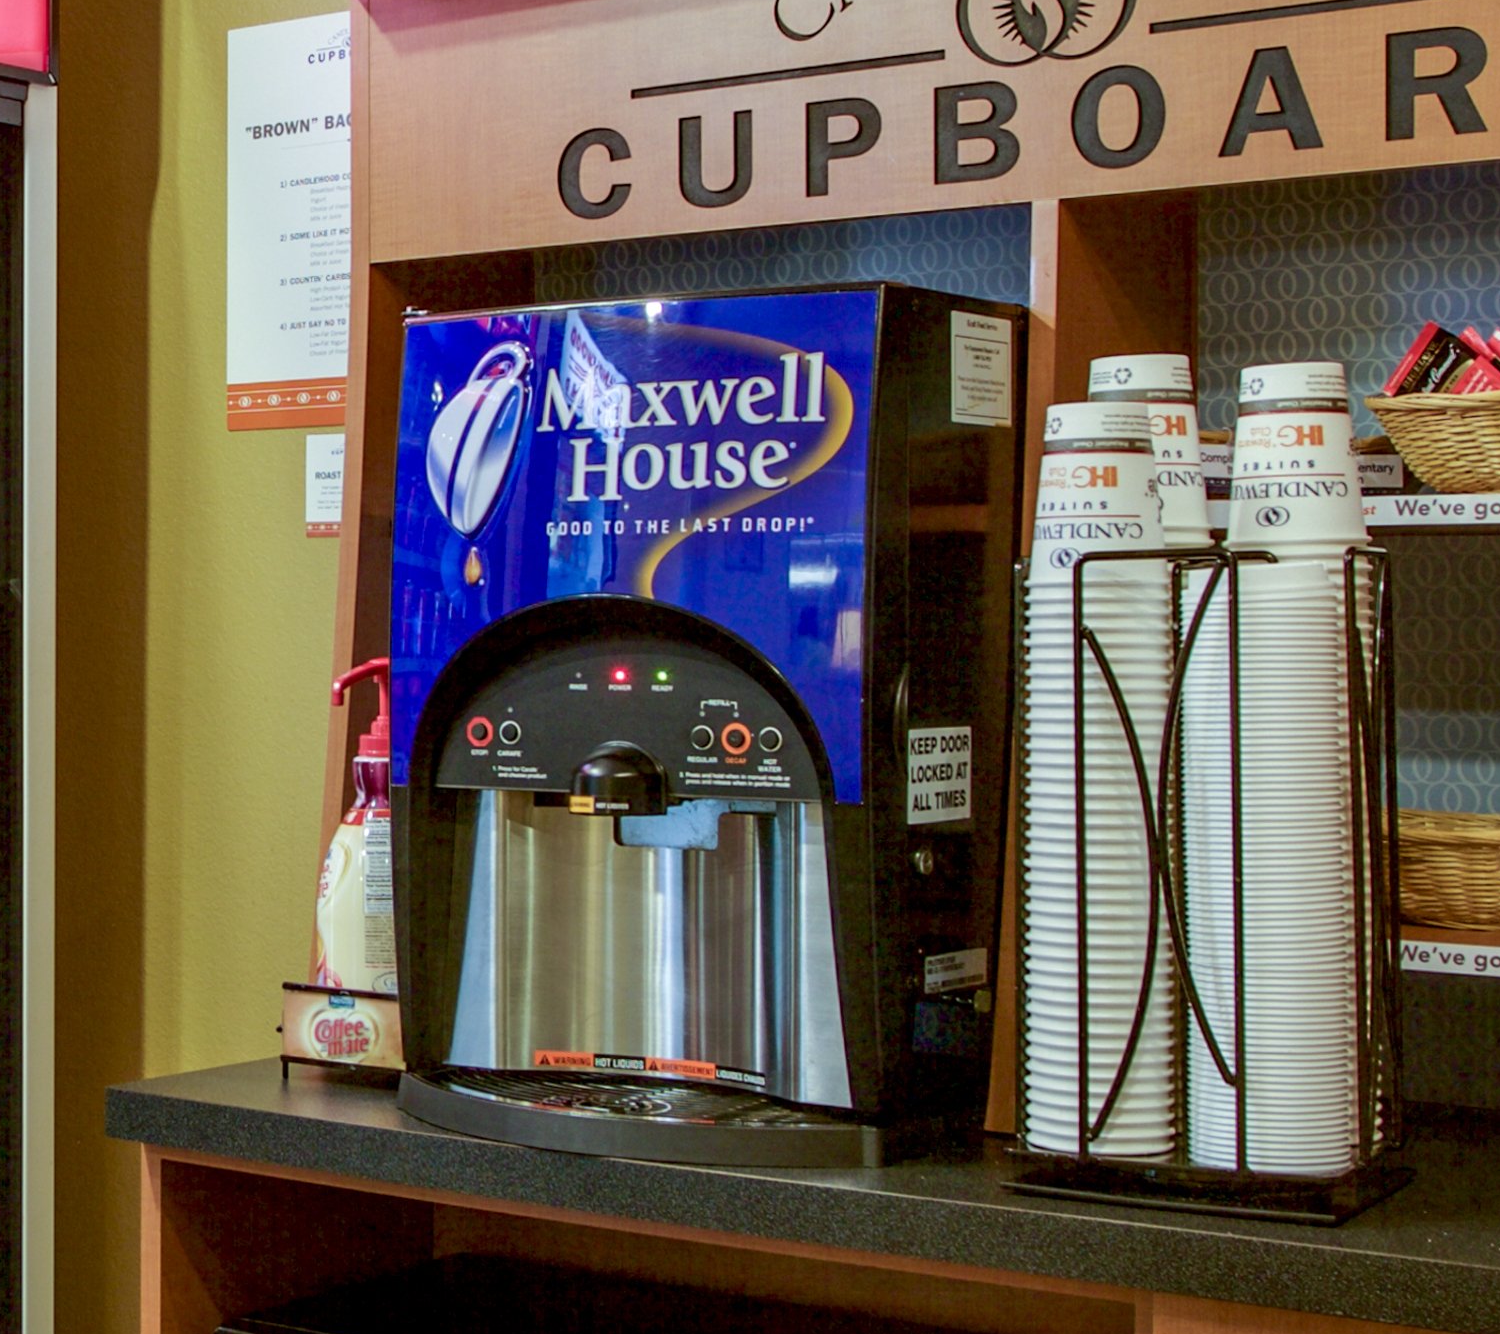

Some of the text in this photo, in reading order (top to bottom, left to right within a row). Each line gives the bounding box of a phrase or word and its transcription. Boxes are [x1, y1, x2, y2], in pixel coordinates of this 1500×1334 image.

[289, 174, 340, 187] CANDLEWOOD
[537, 351, 827, 432] Maxwell
[1276, 424, 1325, 449] IHG
[566, 439, 790, 503] House
[1072, 466, 1119, 490] IHG
[1394, 496, 1468, 518] We've
[546, 515, 807, 536] GOOD TO THE LAST DROP!
[608, 684, 674, 693] POWER READY
[910, 734, 970, 756] KEEP DOOR
[686, 755, 718, 764] REGULAR
[757, 765, 782, 774] WATER
[911, 762, 968, 784] LOCKED AT
[912, 789, 967, 813] ALL TIMES
[1398, 942, 1467, 967] We've
[553, 1055, 645, 1070] WARNING HOT LIQUIDS
